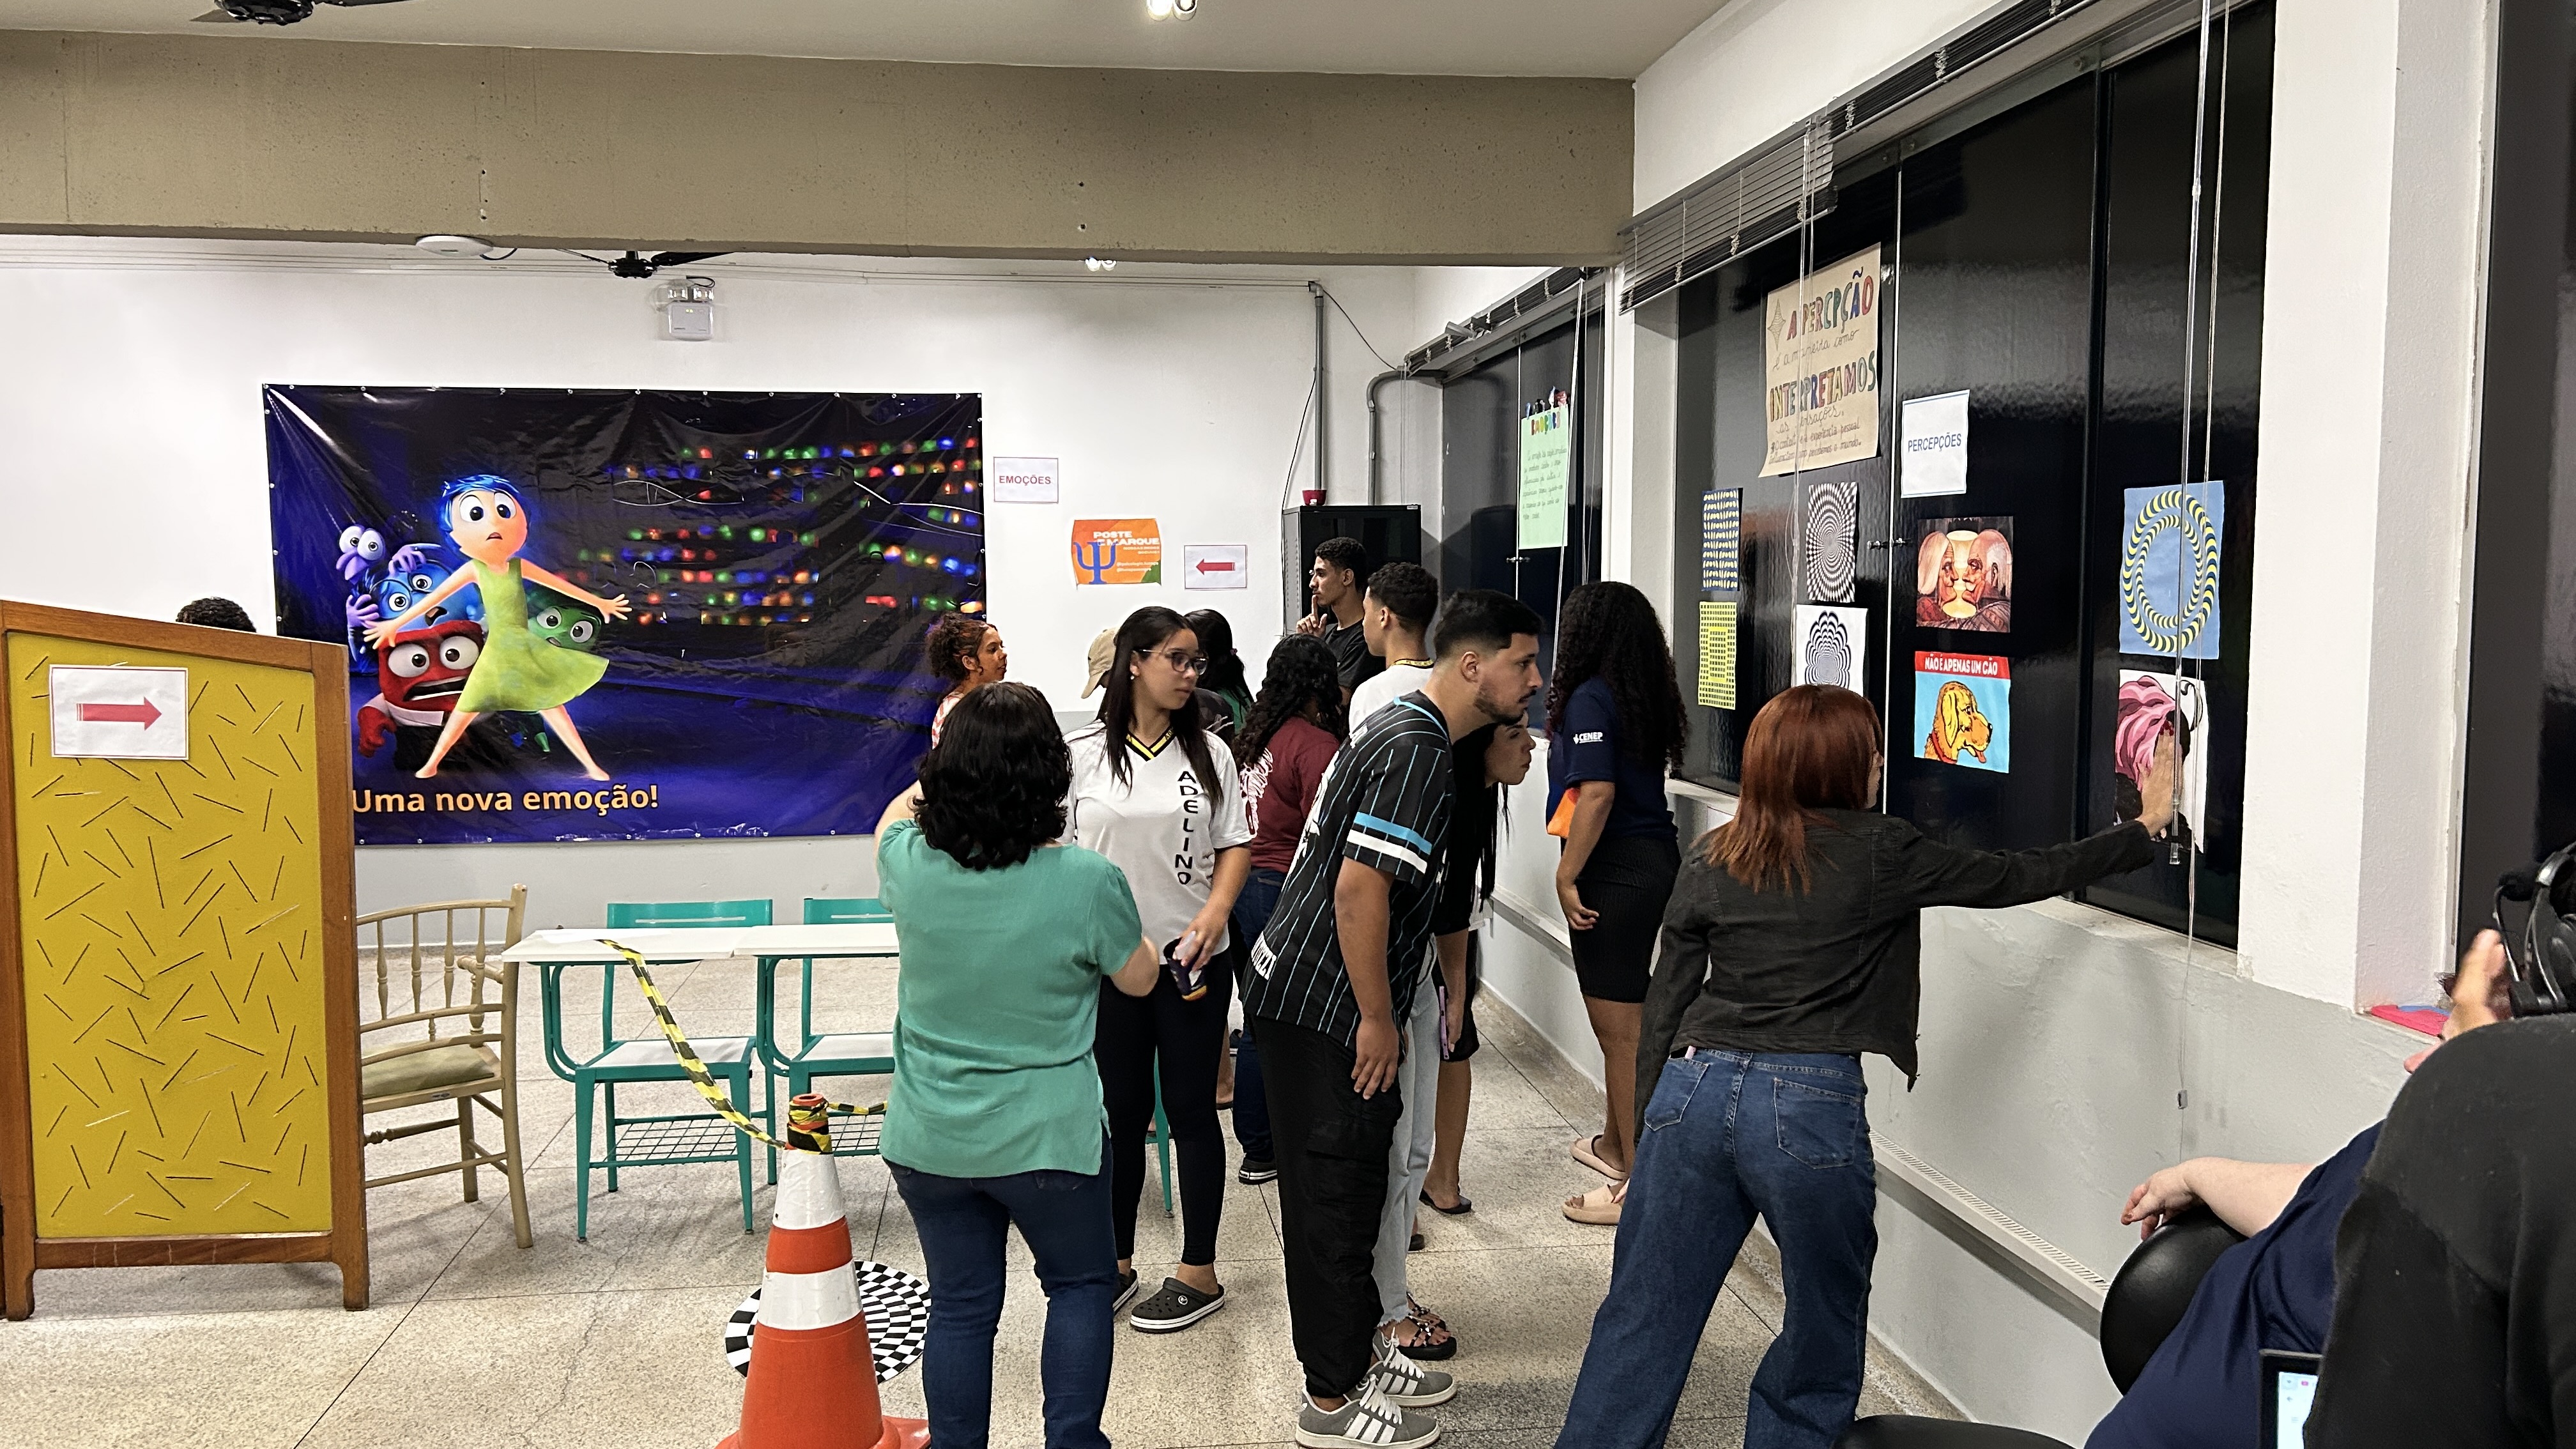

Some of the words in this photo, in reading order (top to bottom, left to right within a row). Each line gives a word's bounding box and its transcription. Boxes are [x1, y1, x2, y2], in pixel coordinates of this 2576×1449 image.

[1787, 310, 1797, 341] A
[1834, 329, 1860, 348] como
[1908, 432, 1961, 452] PERCEPÇÕES
[999, 474, 1052, 486] EMOÇÕES
[1107, 537, 1160, 546] MARQUE
[1924, 653, 1938, 670] NÃO
[1939, 654, 1943, 671] É
[1943, 658, 1971, 673] APENAS
[1971, 660, 1982, 674] UM
[1982, 657, 1998, 675] CÃO
[1578, 732, 1604, 741] CENEP
[353, 788, 425, 813] Uma
[436, 788, 512, 812] nova
[523, 784, 659, 816] emoção!
[1174, 770, 1199, 885] ADELINO
